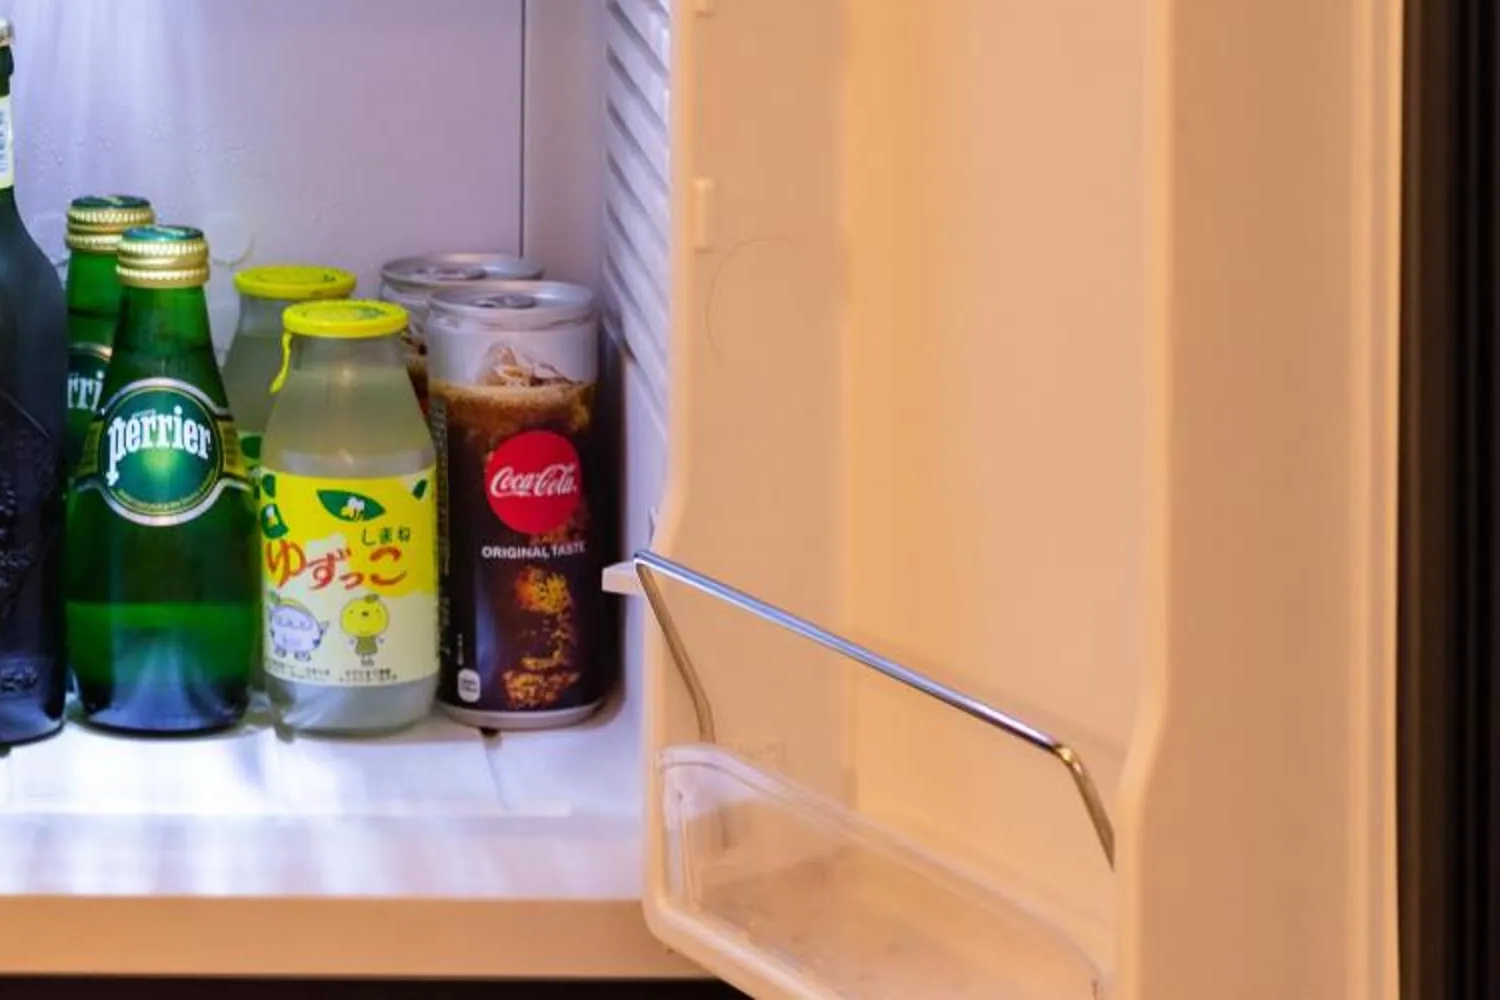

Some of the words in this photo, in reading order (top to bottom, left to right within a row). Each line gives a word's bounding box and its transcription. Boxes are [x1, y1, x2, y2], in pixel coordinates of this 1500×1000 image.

[106, 405, 211, 487] perrier
[490, 463, 577, 498] Coca-Cola
[266, 538, 407, 591] ゆずっこ
[481, 546, 550, 559] ORIGINAL
[551, 541, 586, 557] TASTE
